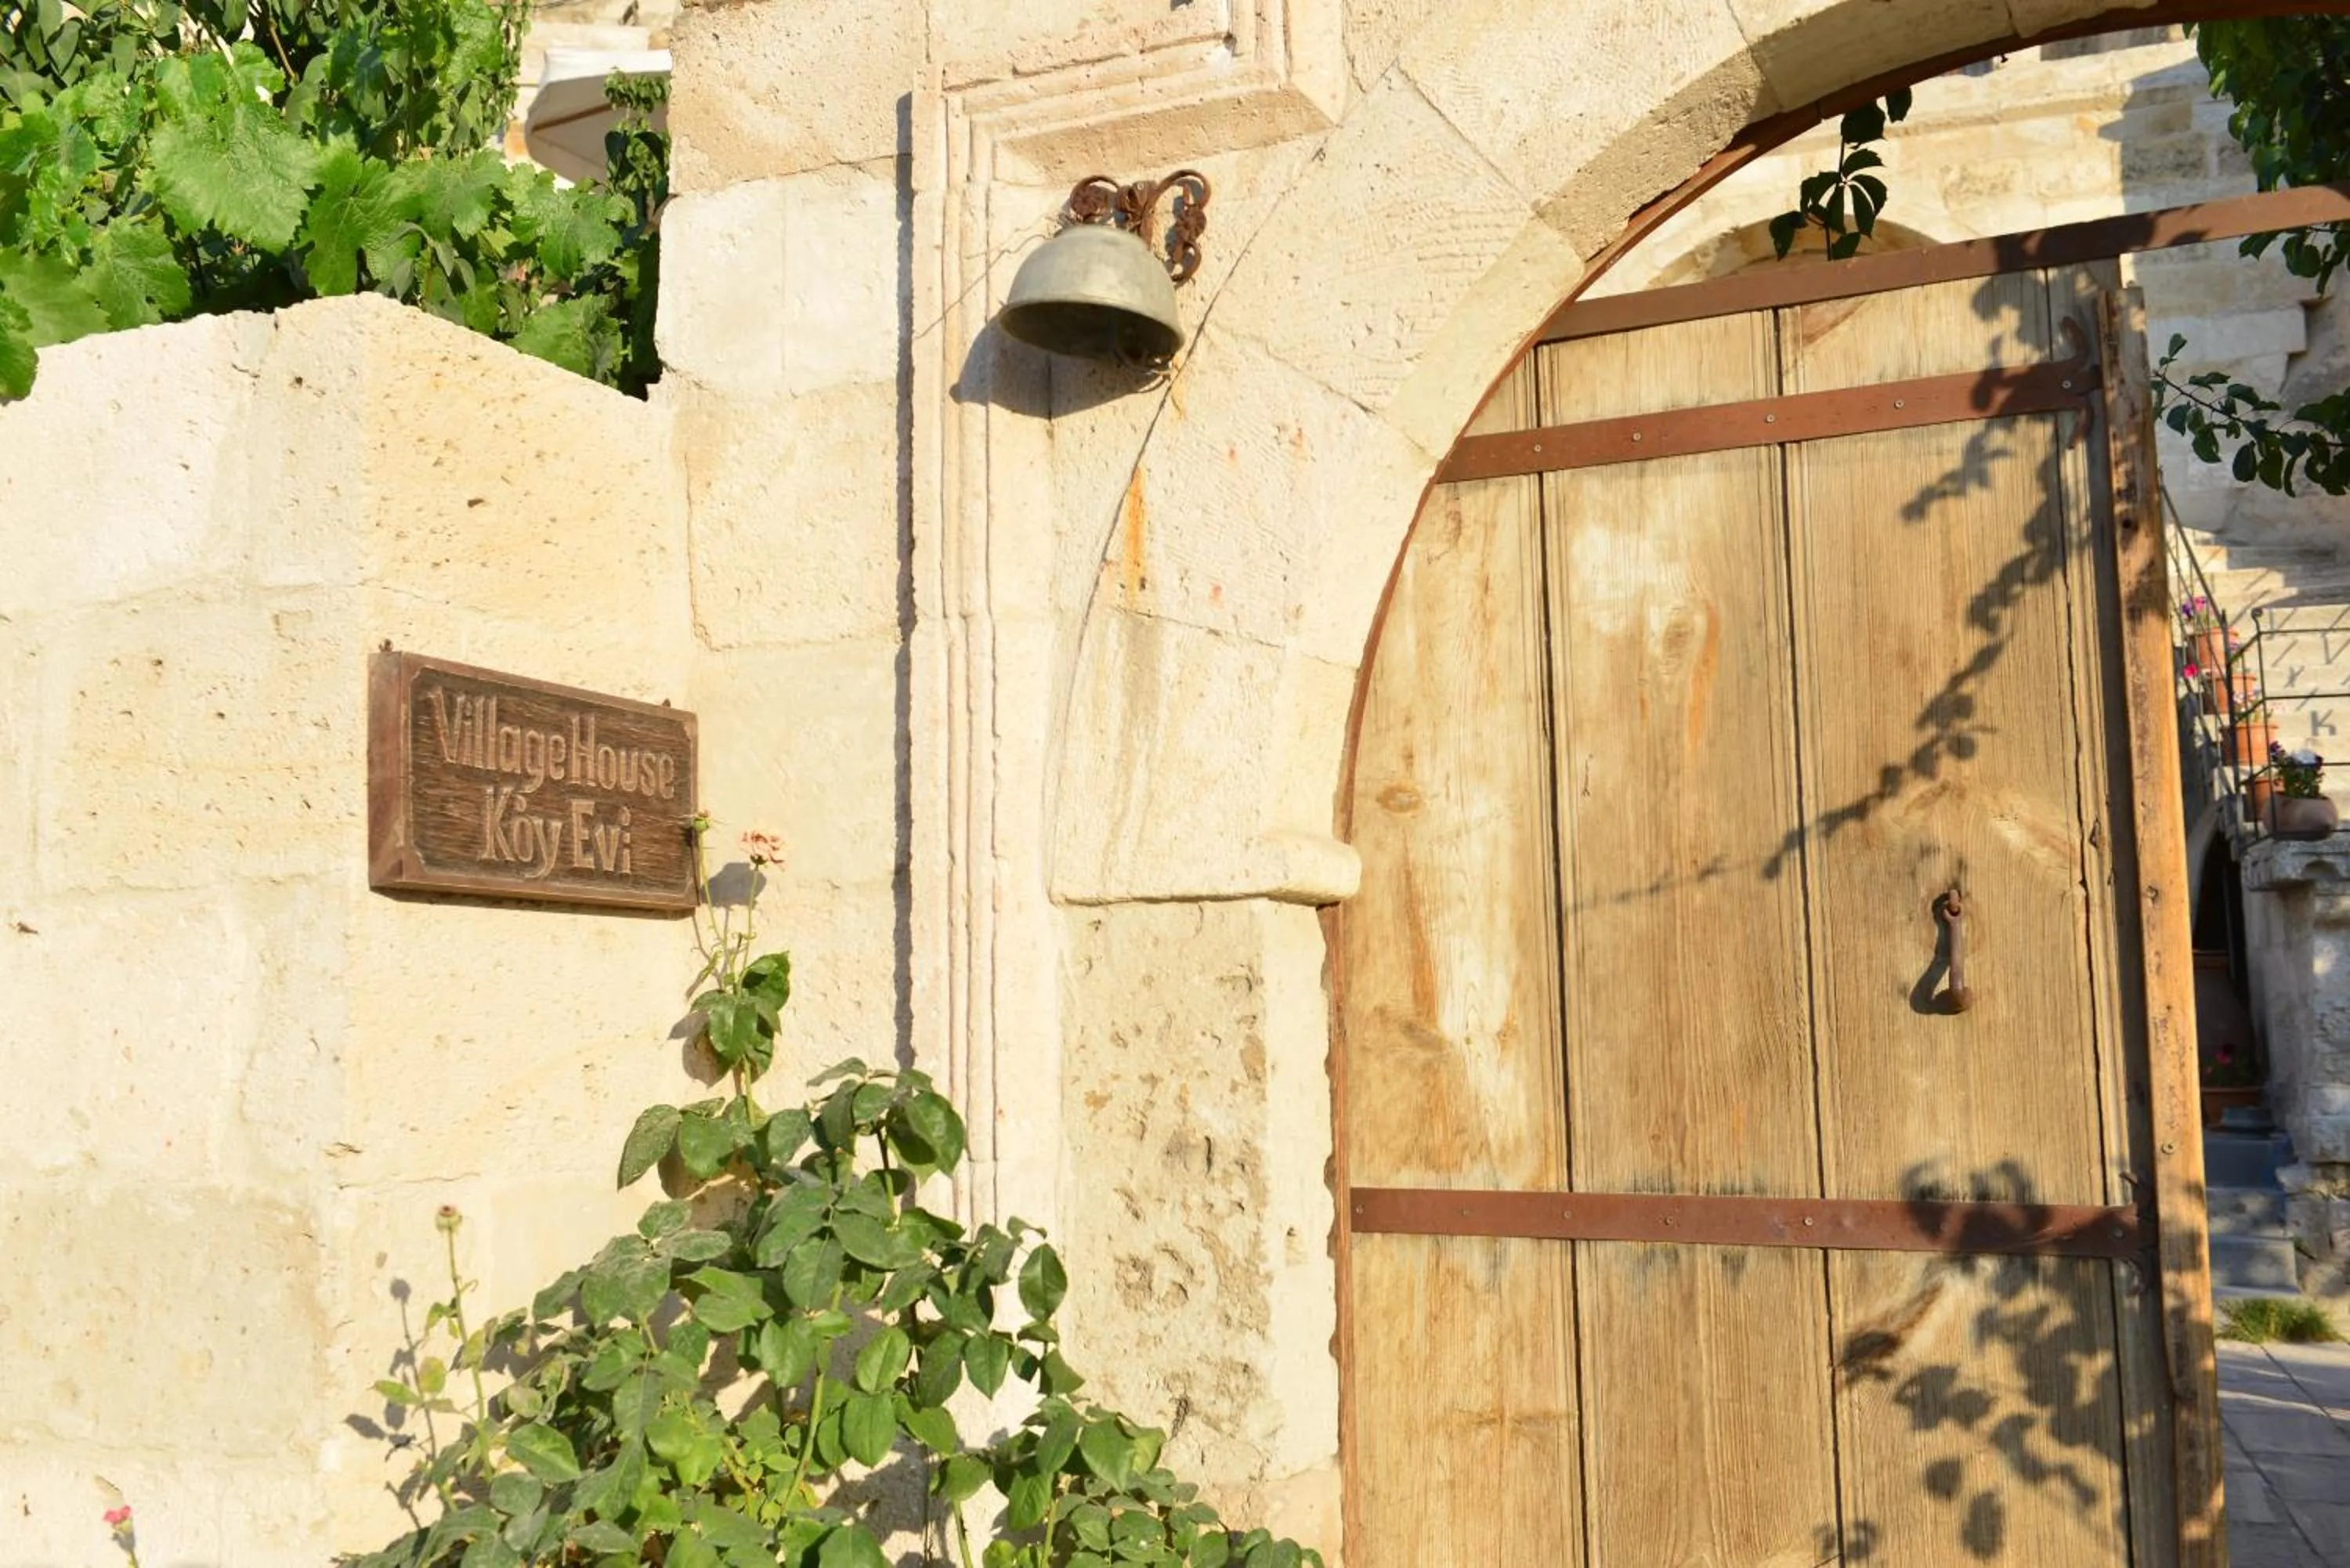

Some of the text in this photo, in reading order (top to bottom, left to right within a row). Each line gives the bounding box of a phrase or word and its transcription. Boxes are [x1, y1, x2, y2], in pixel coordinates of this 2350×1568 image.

[428, 687, 675, 800] Village House
[570, 798, 632, 875] Evi
